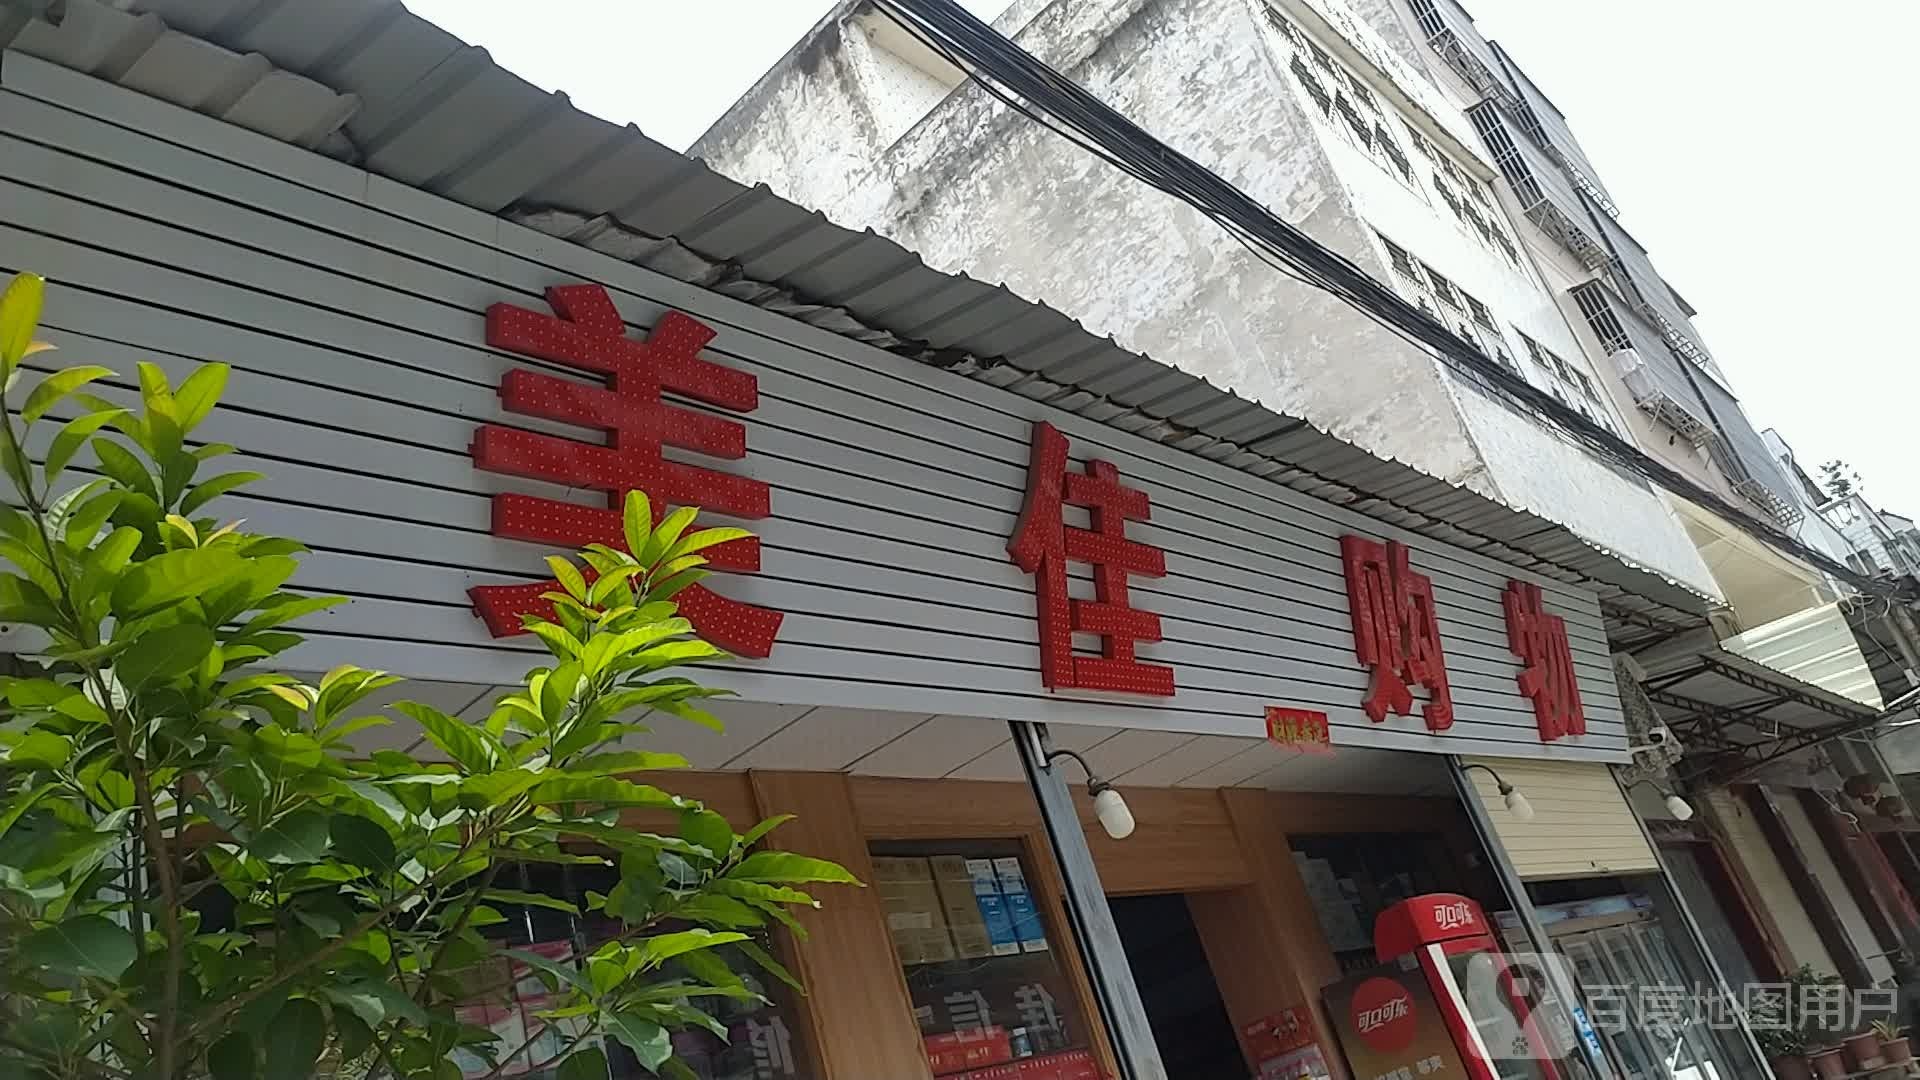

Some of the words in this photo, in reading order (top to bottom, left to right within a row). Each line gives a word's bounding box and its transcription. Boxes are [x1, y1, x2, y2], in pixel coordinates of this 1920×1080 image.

[467, 284, 1586, 741] 美佳购物
[1433, 901, 1474, 930] 可口可乐
[1358, 996, 1409, 1032] 可口可乐
